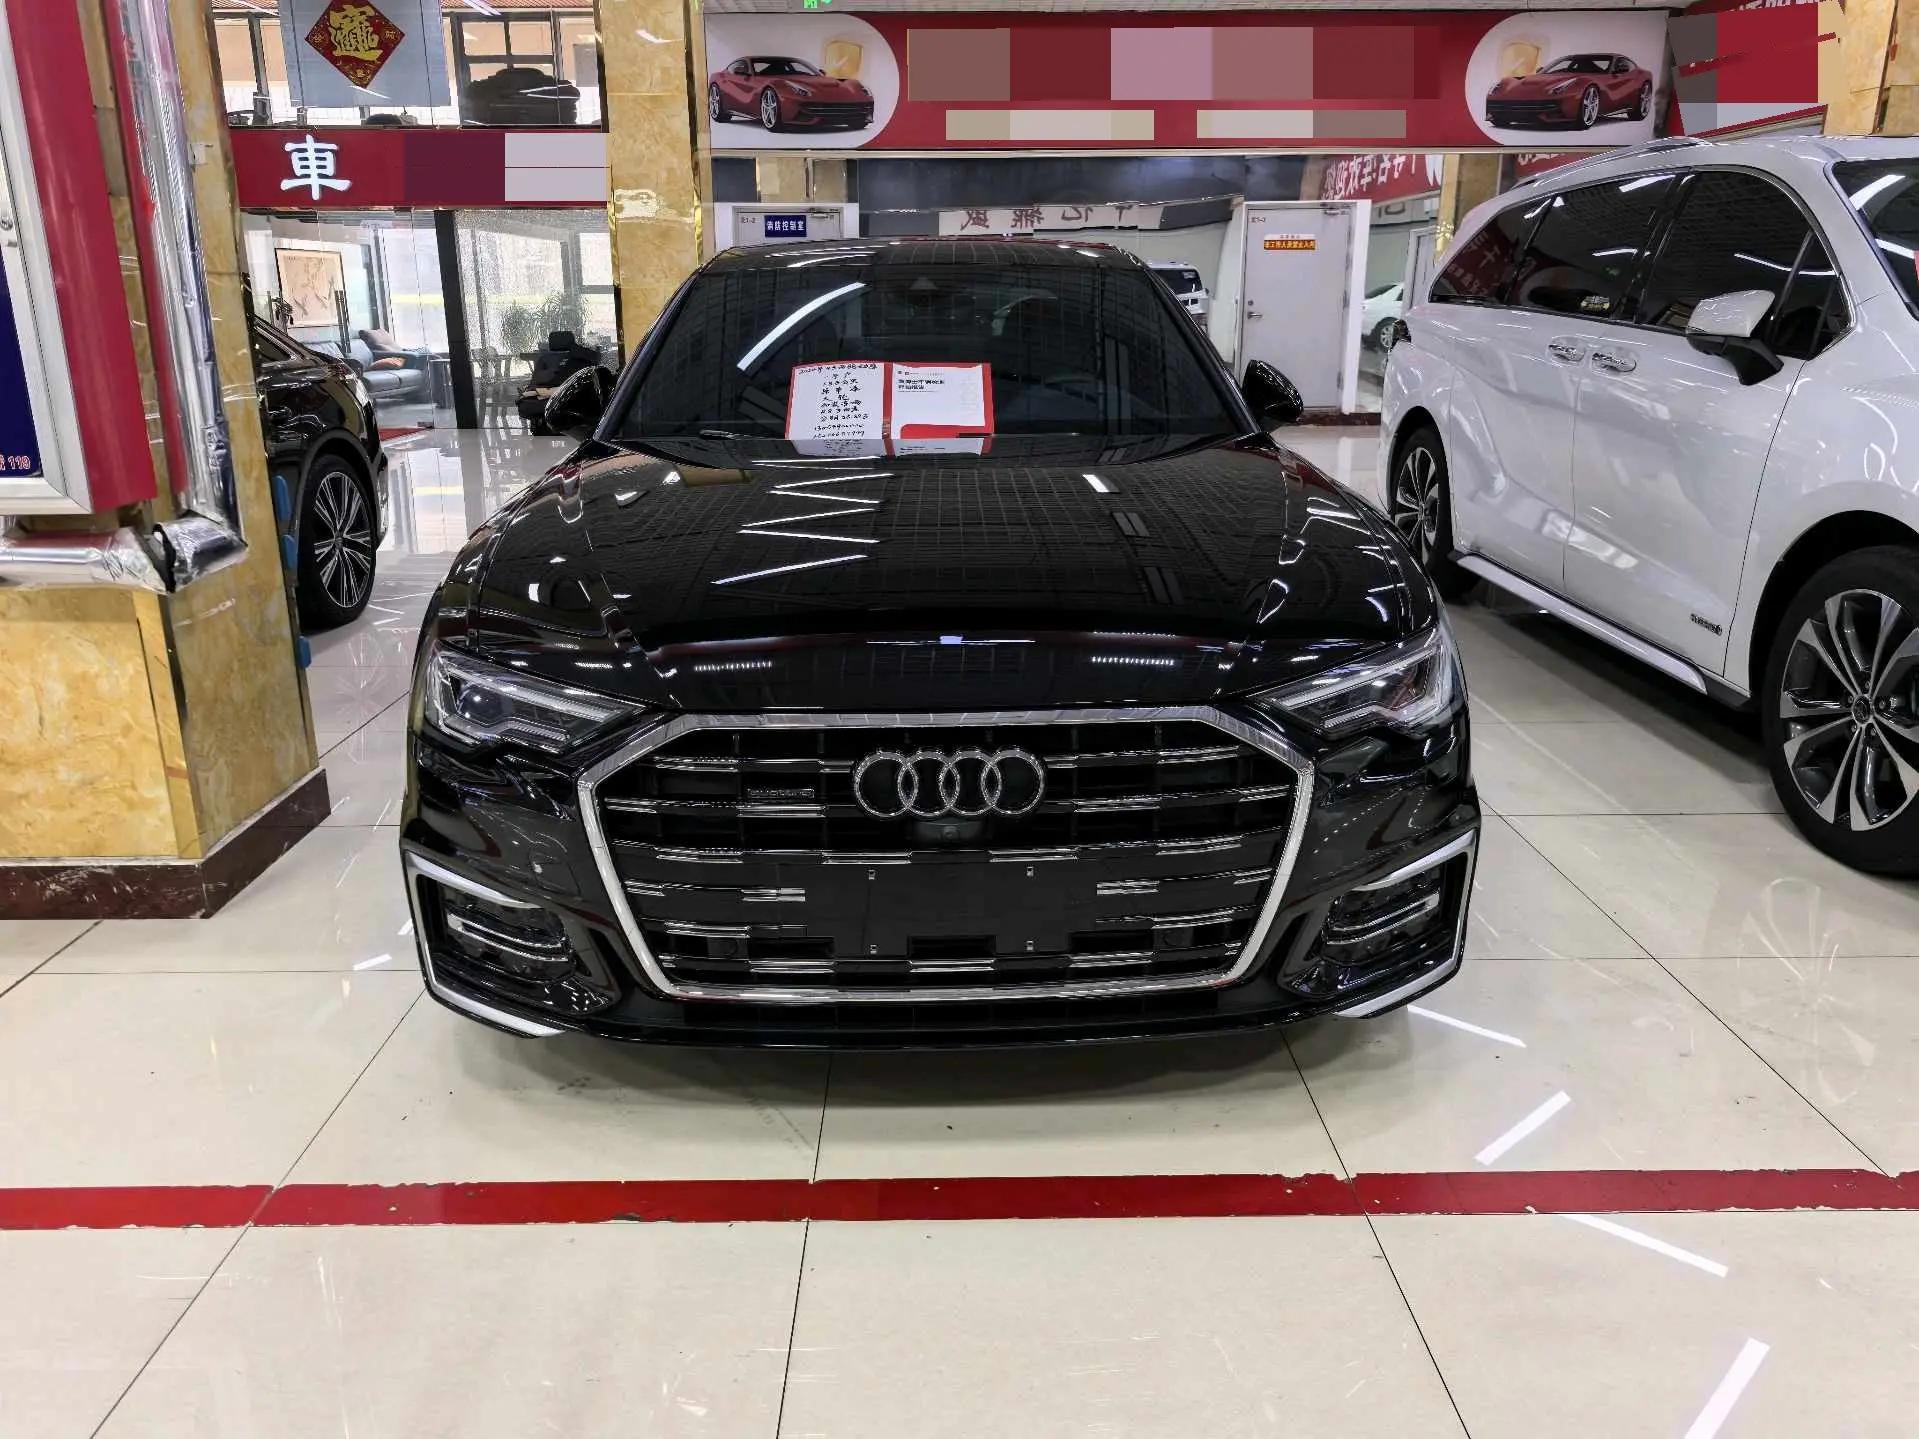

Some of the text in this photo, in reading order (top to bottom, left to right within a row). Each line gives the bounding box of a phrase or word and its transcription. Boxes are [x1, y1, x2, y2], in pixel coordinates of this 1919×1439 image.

[280, 133, 351, 200] 車
[766, 220, 805, 231] 消防控制室
[7, 455, 31, 469] 119
